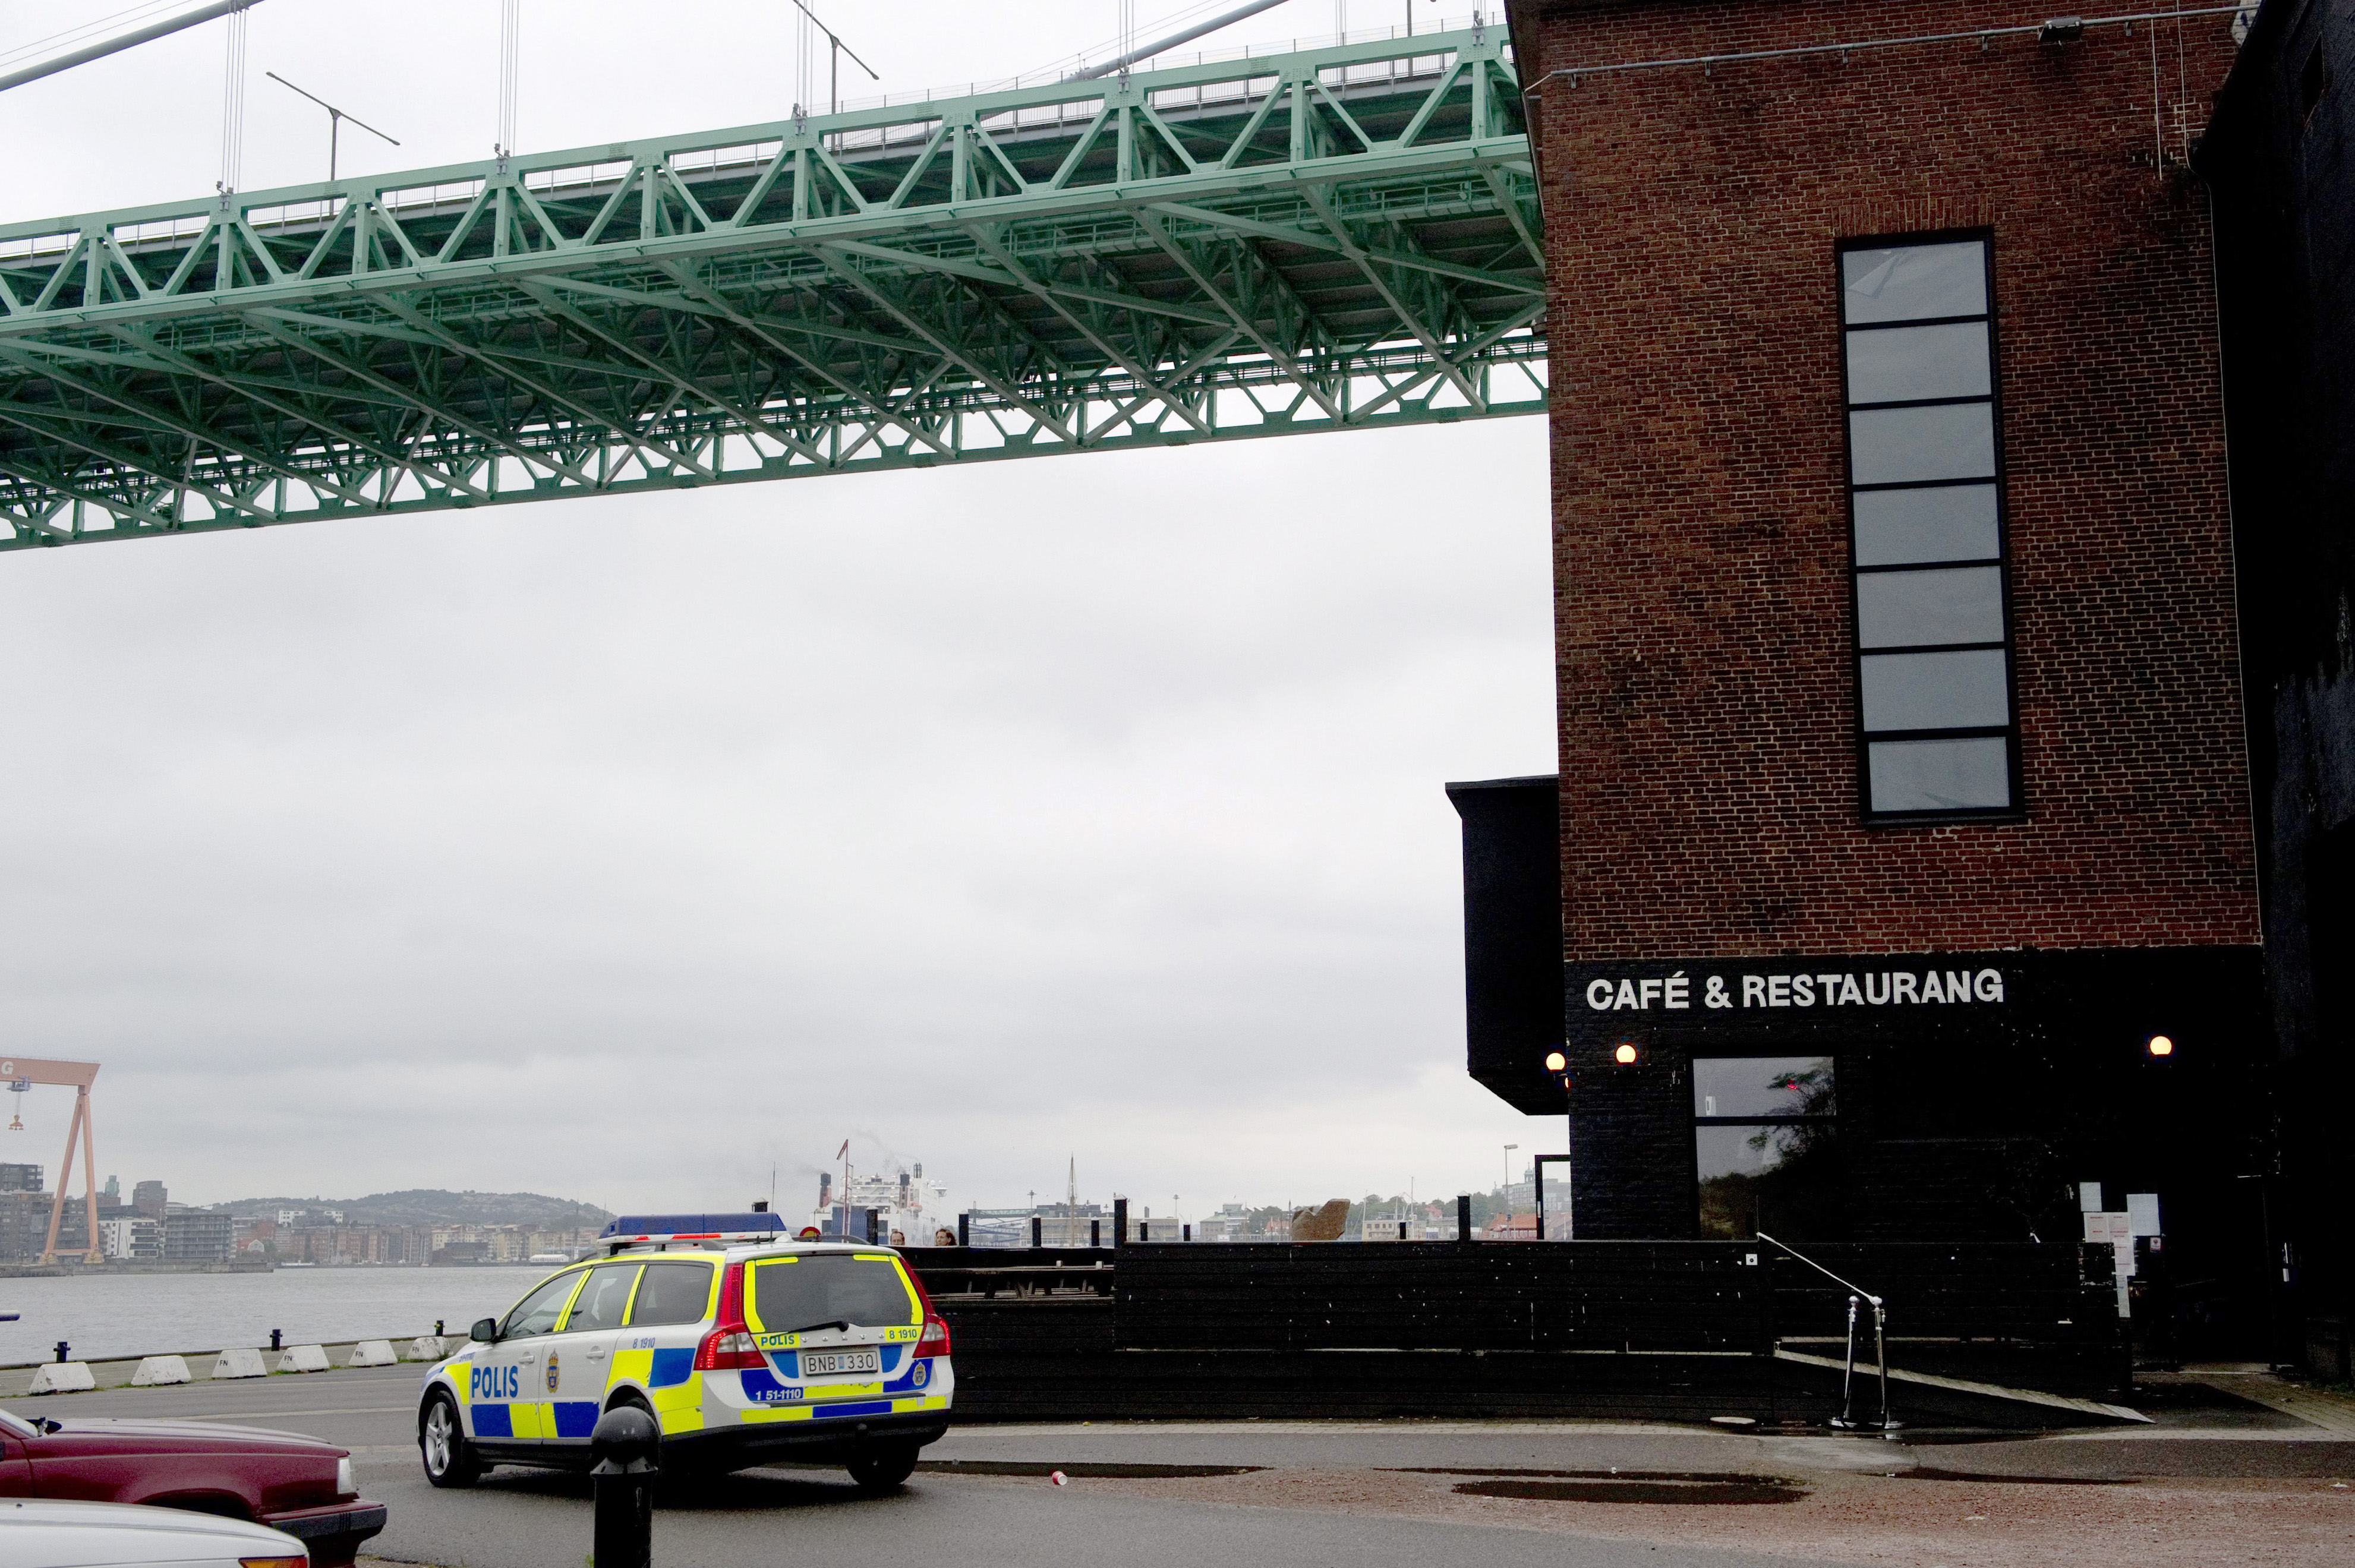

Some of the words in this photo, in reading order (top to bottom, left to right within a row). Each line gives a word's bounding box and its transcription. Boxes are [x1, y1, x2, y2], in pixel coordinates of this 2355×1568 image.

[1586, 970, 1689, 1010] CAFÉ
[1704, 975, 1733, 1008] &
[1742, 969, 2004, 1008] RESTAURANG
[761, 1334, 795, 1346] POLIS
[889, 1330, 895, 1339] 8
[898, 1329, 917, 1338] 1910
[632, 1337, 638, 1349] 8
[640, 1336, 655, 1348] 1910
[809, 1356, 836, 1372] BNB
[847, 1354, 874, 1369] 330
[471, 1365, 518, 1399] POLIS
[765, 1388, 802, 1400] 51-1110
